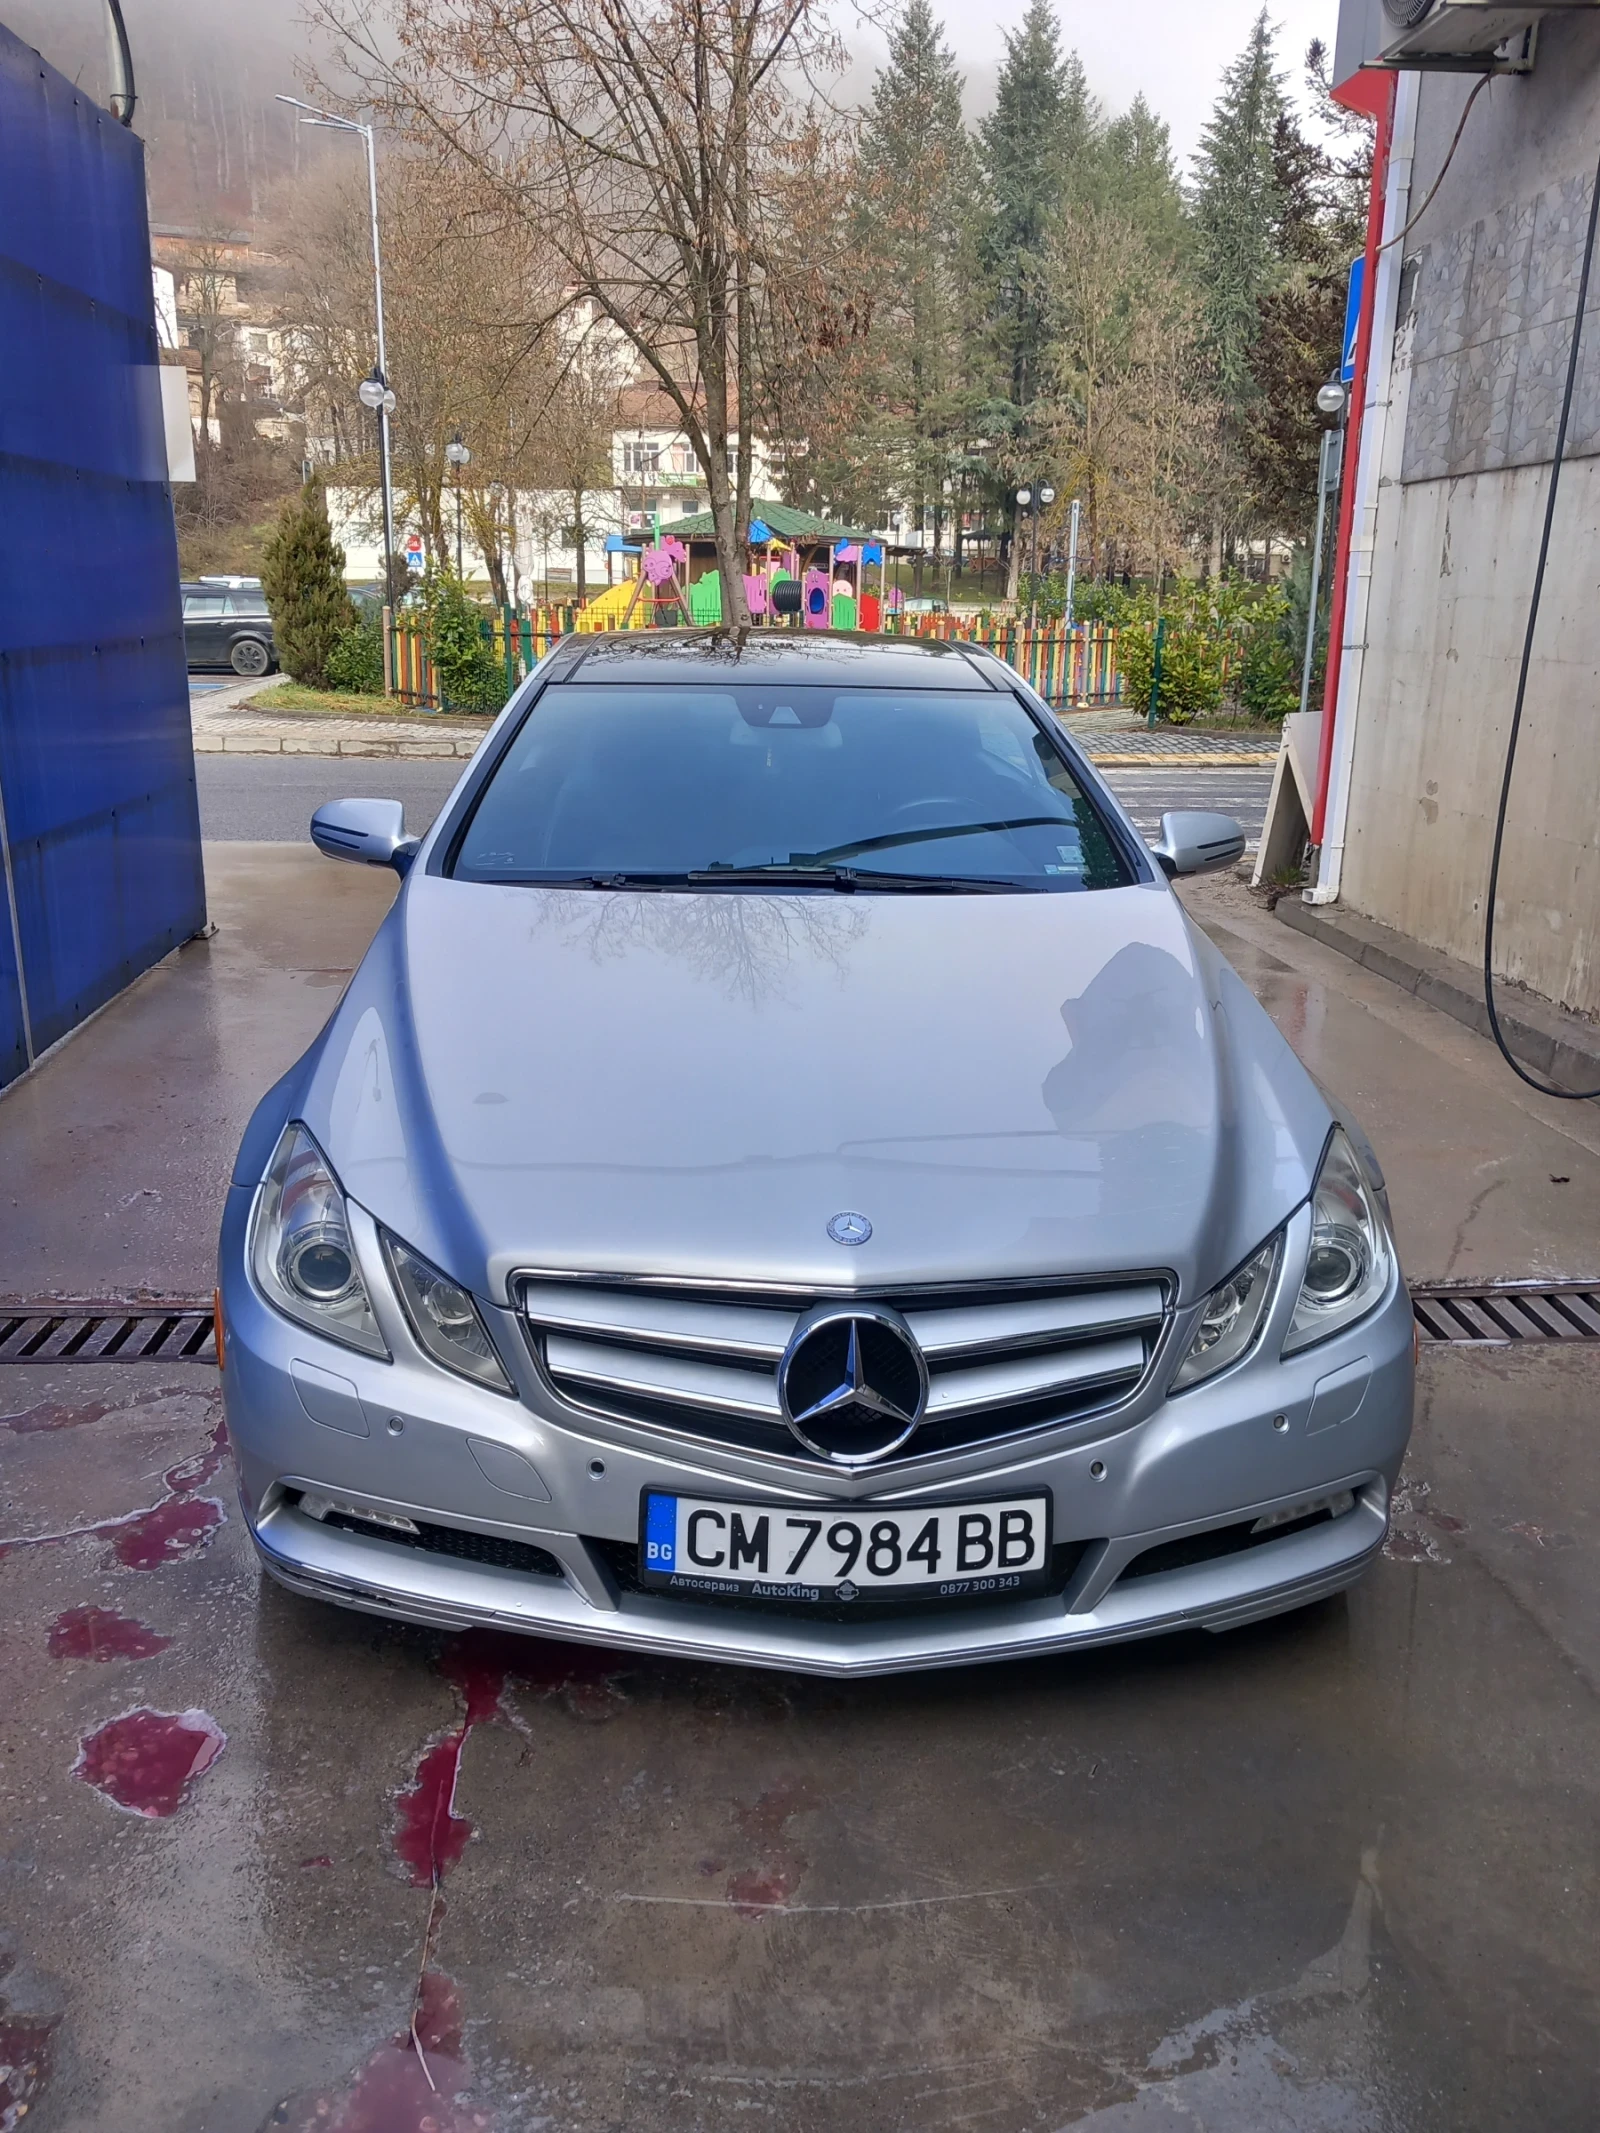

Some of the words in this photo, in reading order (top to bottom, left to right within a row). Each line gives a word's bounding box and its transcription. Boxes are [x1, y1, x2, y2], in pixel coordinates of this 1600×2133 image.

[647, 1541, 673, 1561] BG
[785, 1517, 942, 1578] 7984
[669, 1575, 740, 1593] Автосервиз
[751, 1582, 820, 1601] AutoKing
[940, 1582, 970, 1595] 0877
[972, 1578, 996, 1591] 300
[998, 1575, 1021, 1588] 343
